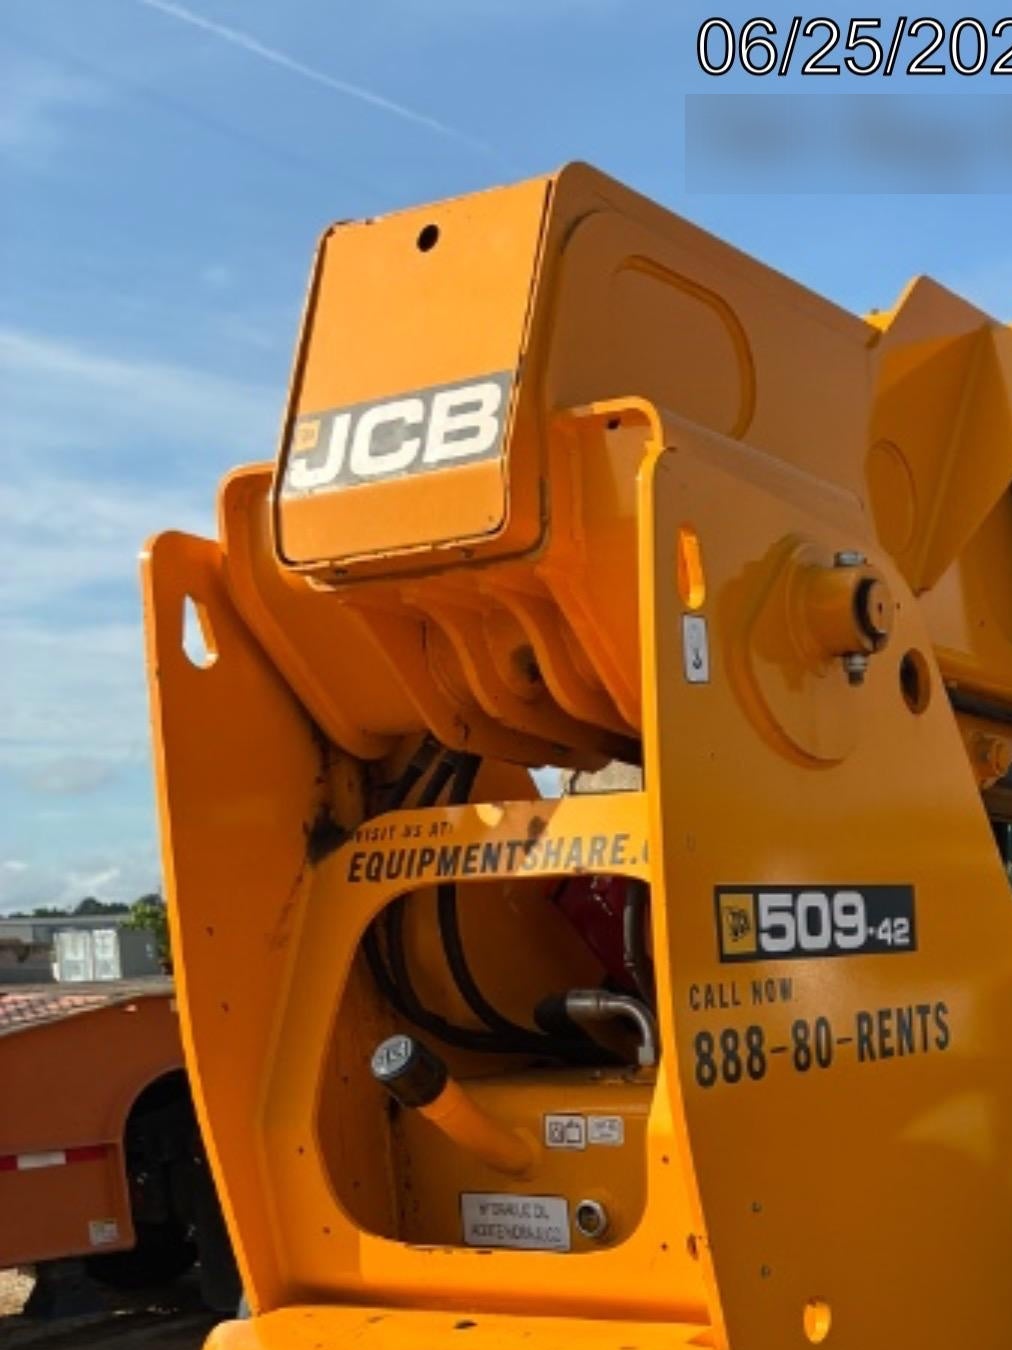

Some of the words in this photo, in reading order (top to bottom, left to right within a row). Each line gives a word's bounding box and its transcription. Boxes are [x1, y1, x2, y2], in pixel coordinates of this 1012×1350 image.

[290, 381, 501, 487] JCB
[348, 832, 649, 883] EQUIPMENTSHARE.
[689, 981, 742, 1012] CALL
[695, 1001, 950, 1088] 888-80-RENTS
